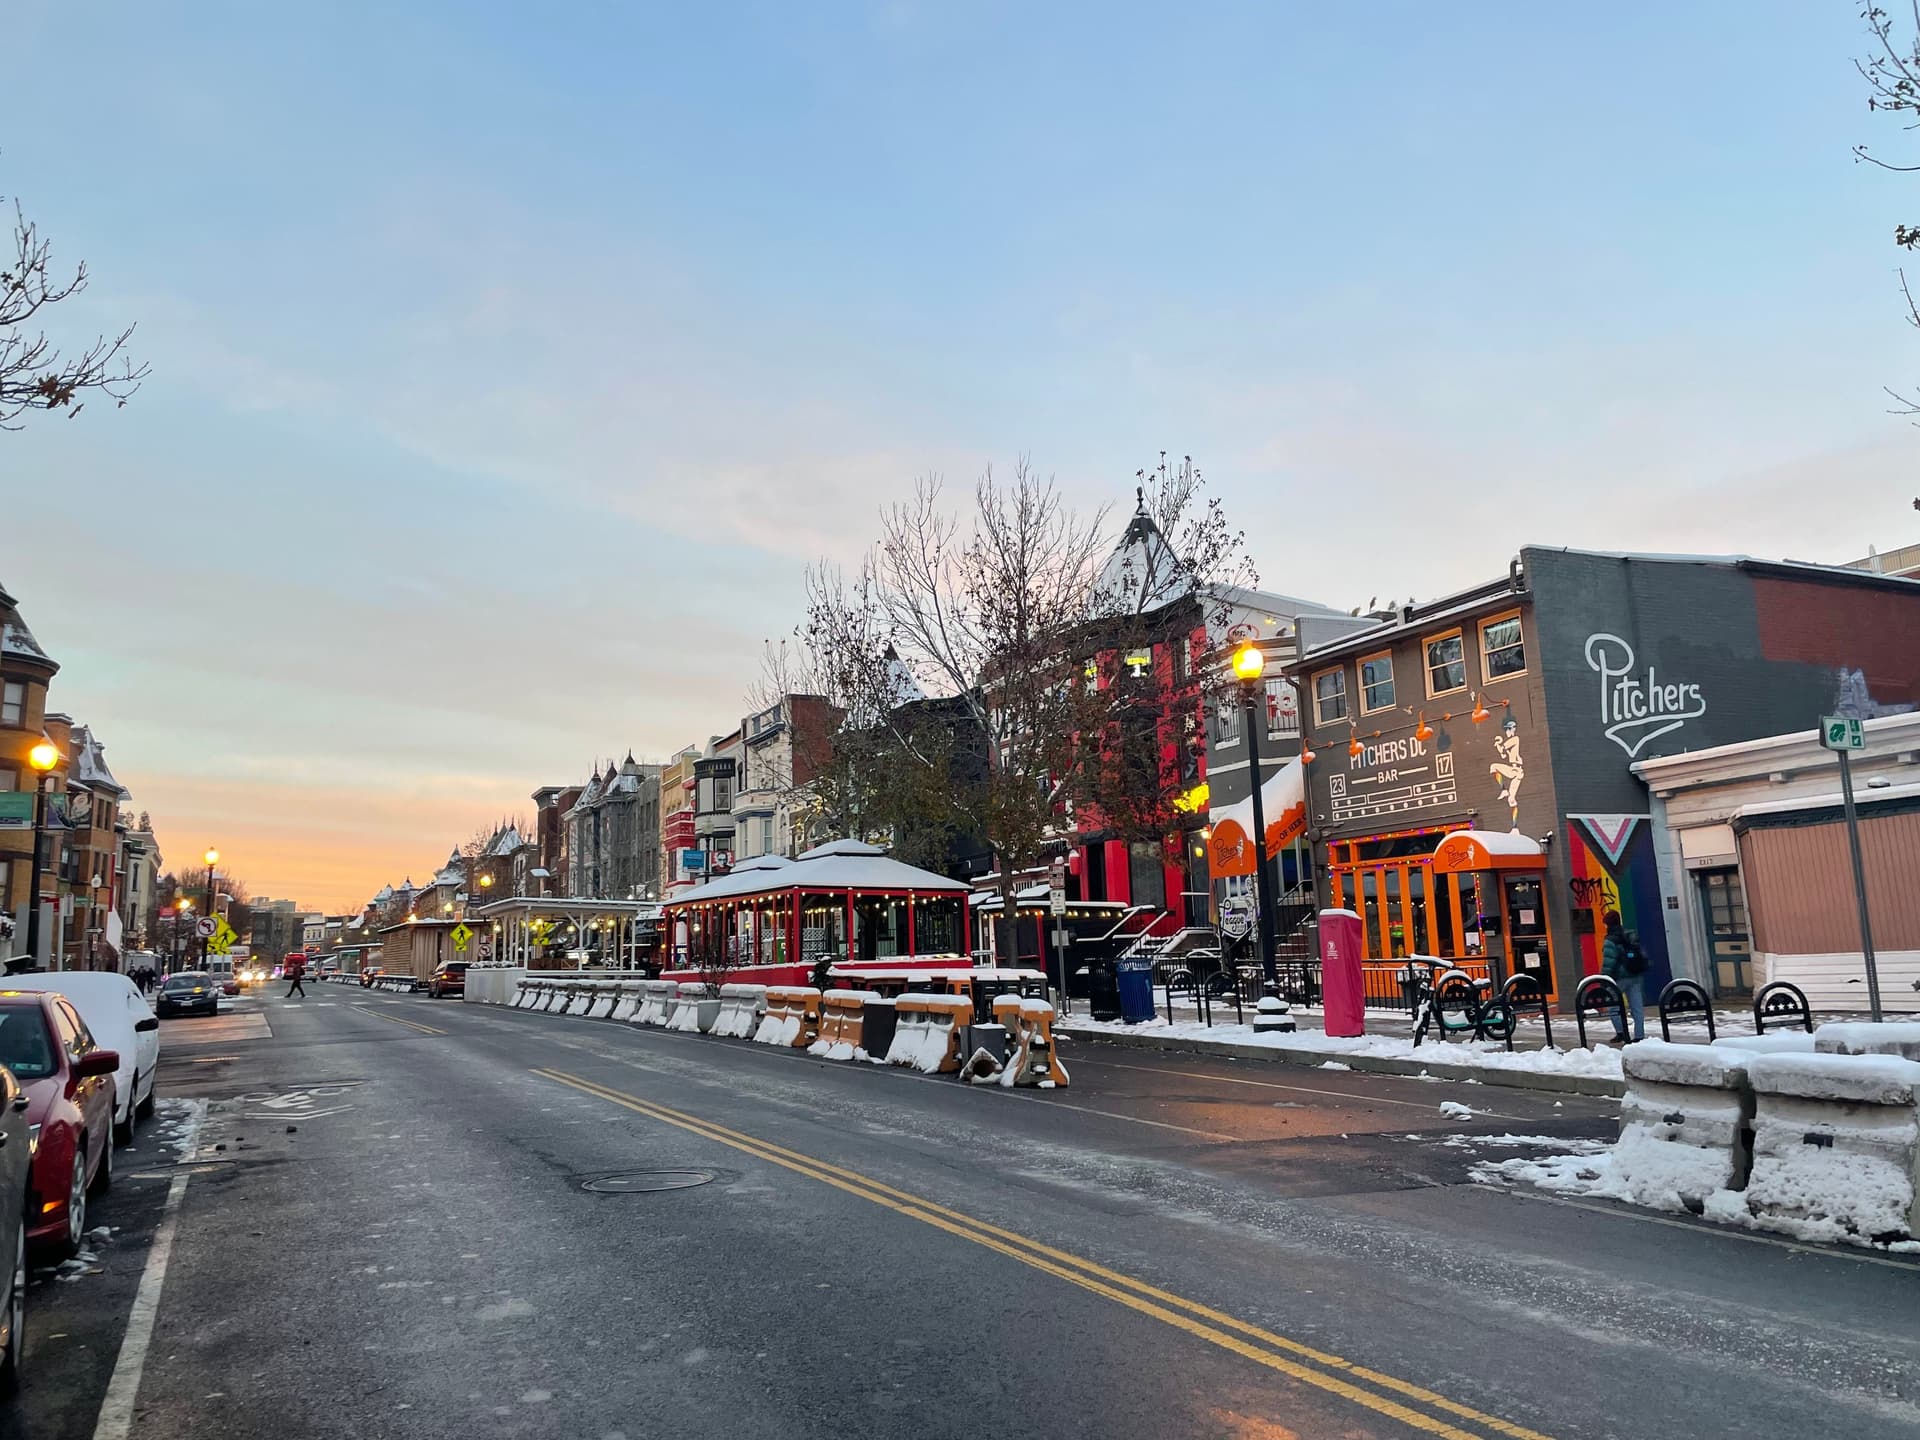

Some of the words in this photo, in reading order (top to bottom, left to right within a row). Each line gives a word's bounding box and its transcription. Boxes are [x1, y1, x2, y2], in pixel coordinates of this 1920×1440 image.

[1584, 633, 1706, 757] Pitchers
[1438, 756, 1451, 774] 17
[1377, 769, 1399, 784] BAR
[1332, 778, 1345, 794] 23
